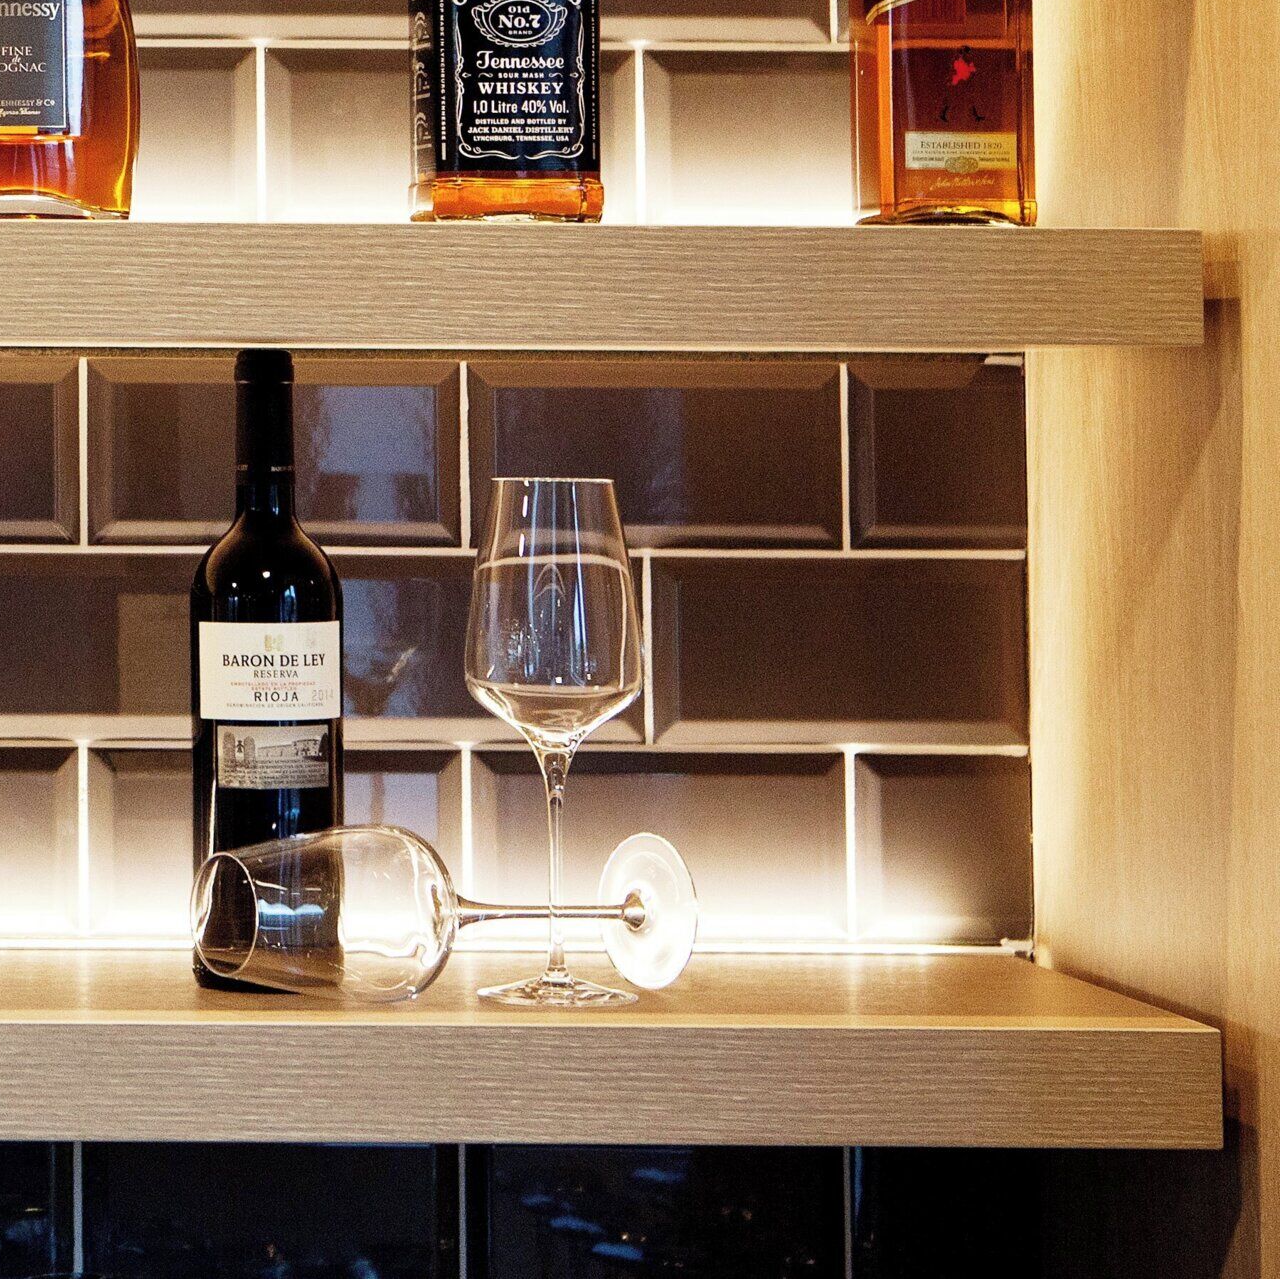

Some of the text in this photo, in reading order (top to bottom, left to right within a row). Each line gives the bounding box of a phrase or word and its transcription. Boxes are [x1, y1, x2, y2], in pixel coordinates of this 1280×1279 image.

[507, 5, 531, 14] Old
[498, 14, 541, 29] No.7
[1, 46, 33, 56] FINE
[11, 55, 22, 63] de
[476, 50, 565, 69] Tennessee
[478, 82, 564, 95] WHISKEY
[491, 100, 518, 113] Litre
[521, 100, 547, 113] 40%
[549, 100, 570, 113] Vol.
[920, 141, 1002, 149] ESTABLISHED 1820
[222, 653, 326, 667] BARON DE LEY
[253, 670, 299, 678] RESERVA
[254, 691, 299, 702] RIOJA
